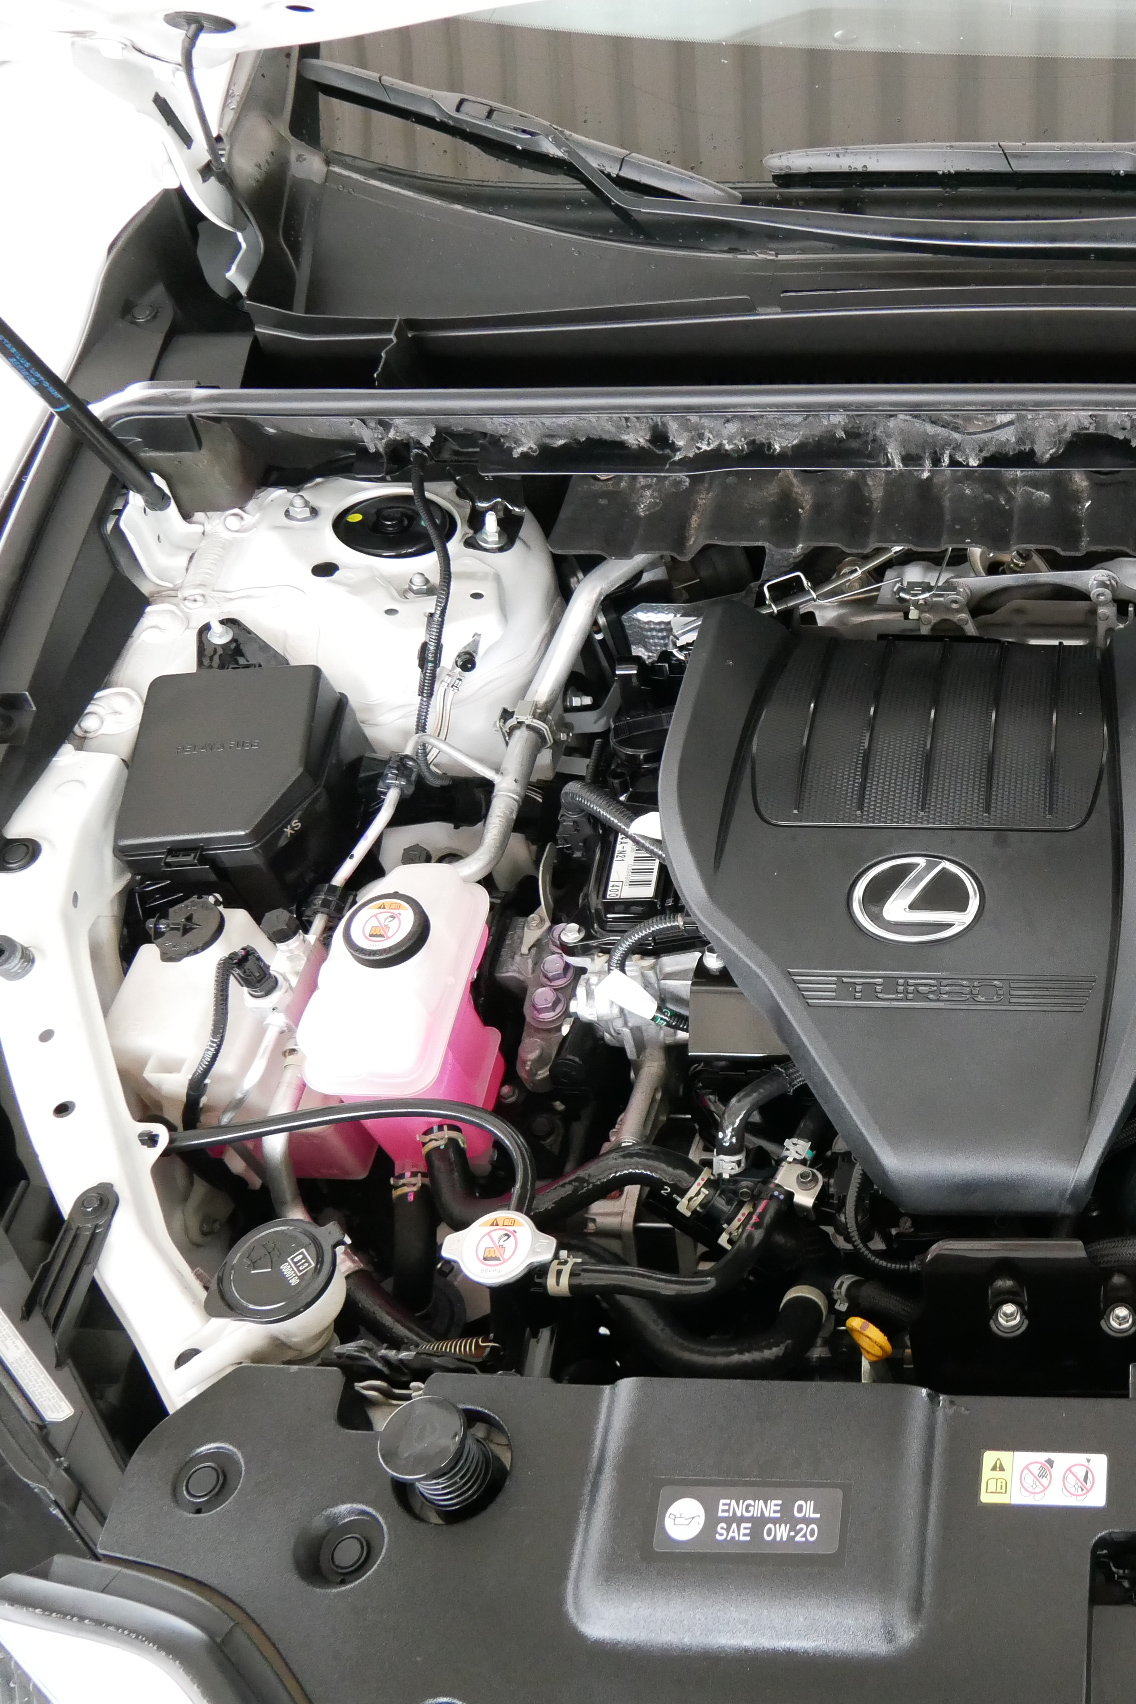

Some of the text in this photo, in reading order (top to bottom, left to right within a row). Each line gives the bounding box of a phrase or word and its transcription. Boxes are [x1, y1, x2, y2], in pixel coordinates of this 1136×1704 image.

[608, 884, 621, 898] 400
[842, 977, 1004, 1003] TURBO
[717, 1499, 820, 1518] ENGINE OIL
[715, 1522, 819, 1542] SAE 0W-20
